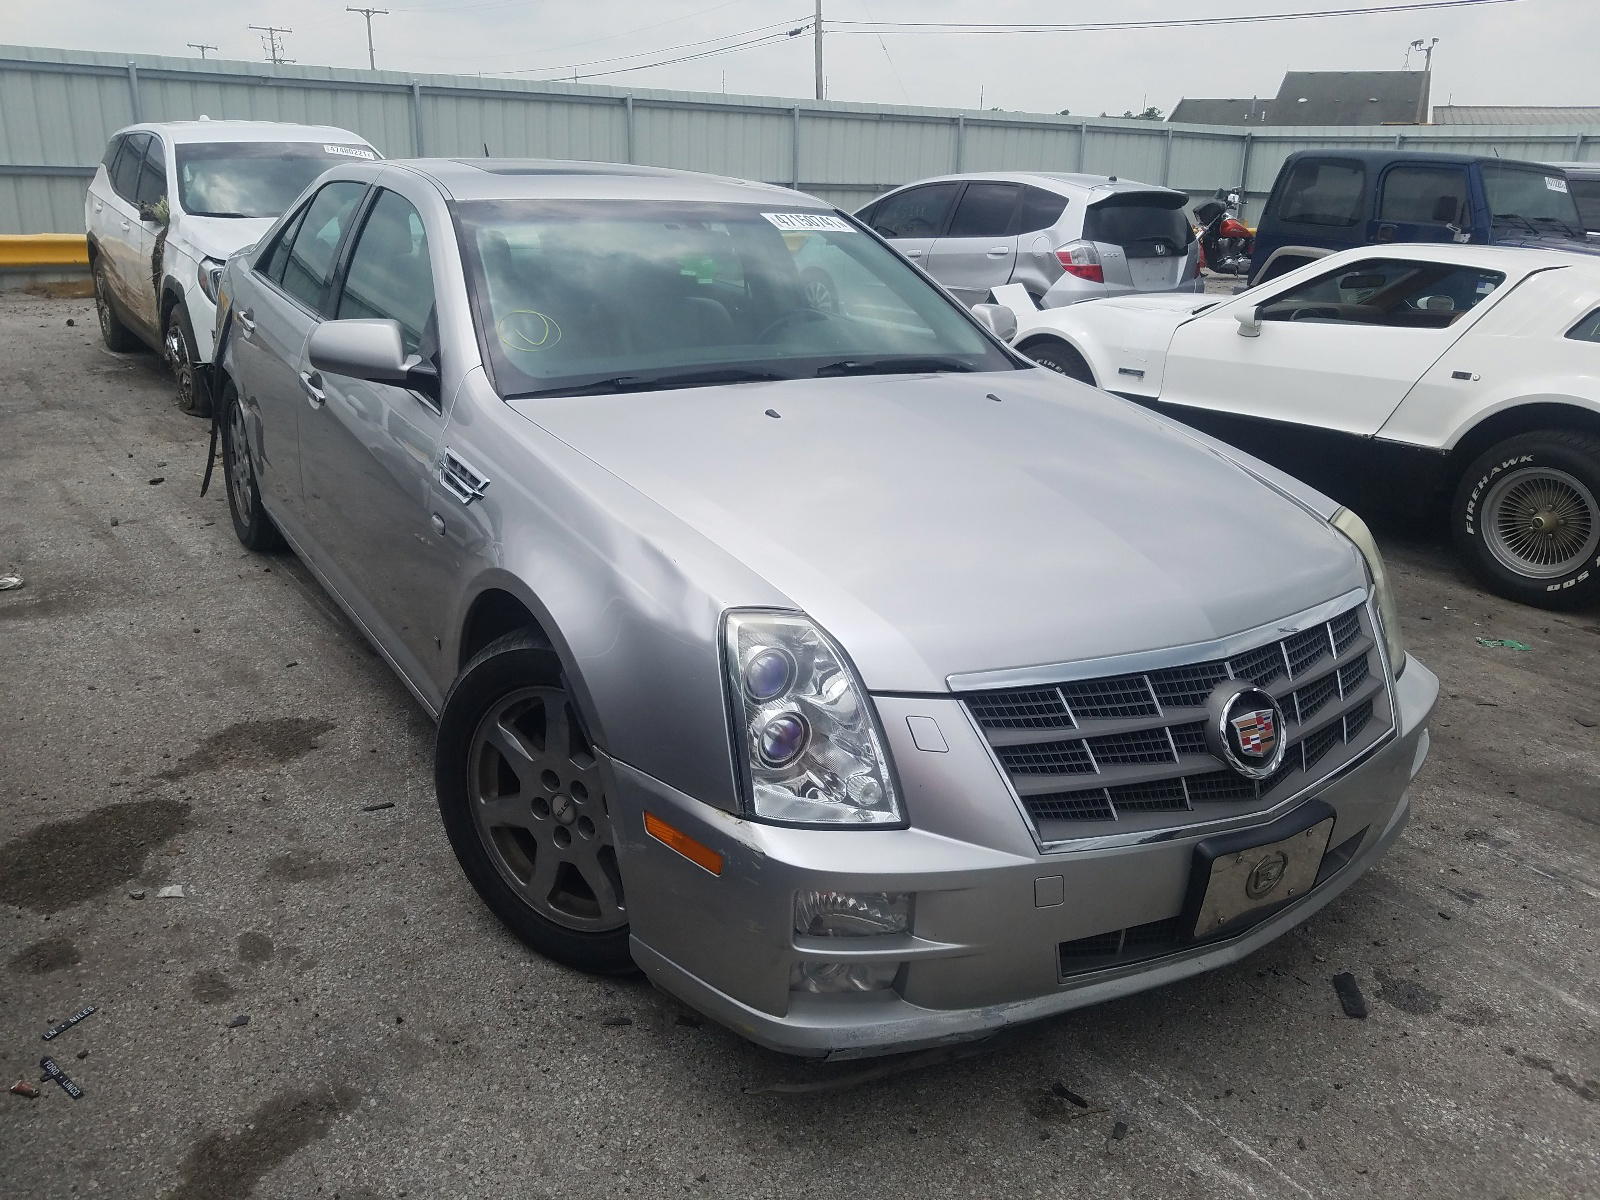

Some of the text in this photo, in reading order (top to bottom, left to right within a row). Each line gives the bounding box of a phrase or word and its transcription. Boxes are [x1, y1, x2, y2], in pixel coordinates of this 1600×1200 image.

[774, 214, 842, 229] 47150741
[1466, 454, 1535, 535] FIREHAWK
[69, 1005, 95, 1023] NILES
[43, 1060, 60, 1076] FORD
